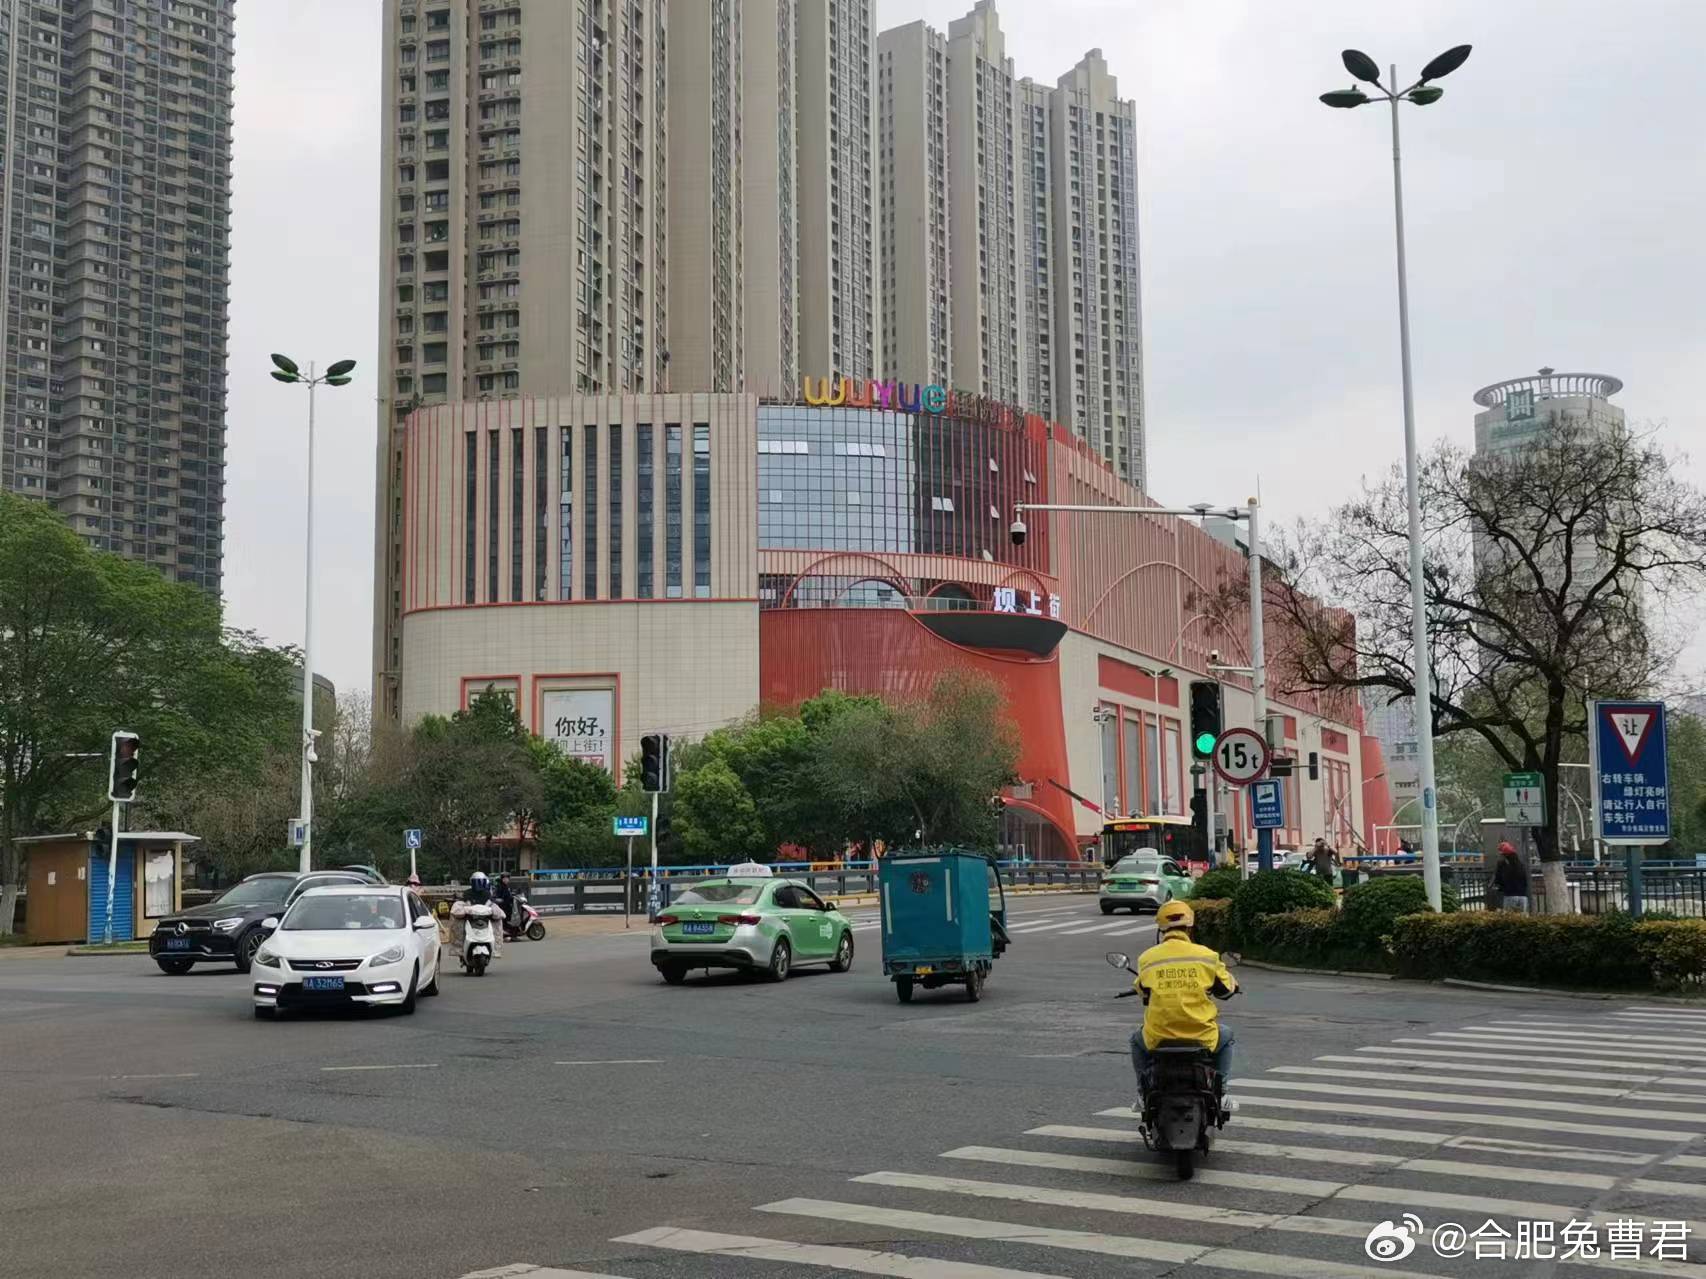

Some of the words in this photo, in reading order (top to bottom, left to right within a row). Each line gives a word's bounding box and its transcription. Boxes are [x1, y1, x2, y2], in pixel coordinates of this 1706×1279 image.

[555, 717, 605, 737] 你好，
[1623, 719, 1638, 736] 让
[1603, 799, 1665, 810] 请让行人自行
[1604, 812, 1635, 823] 车先行
